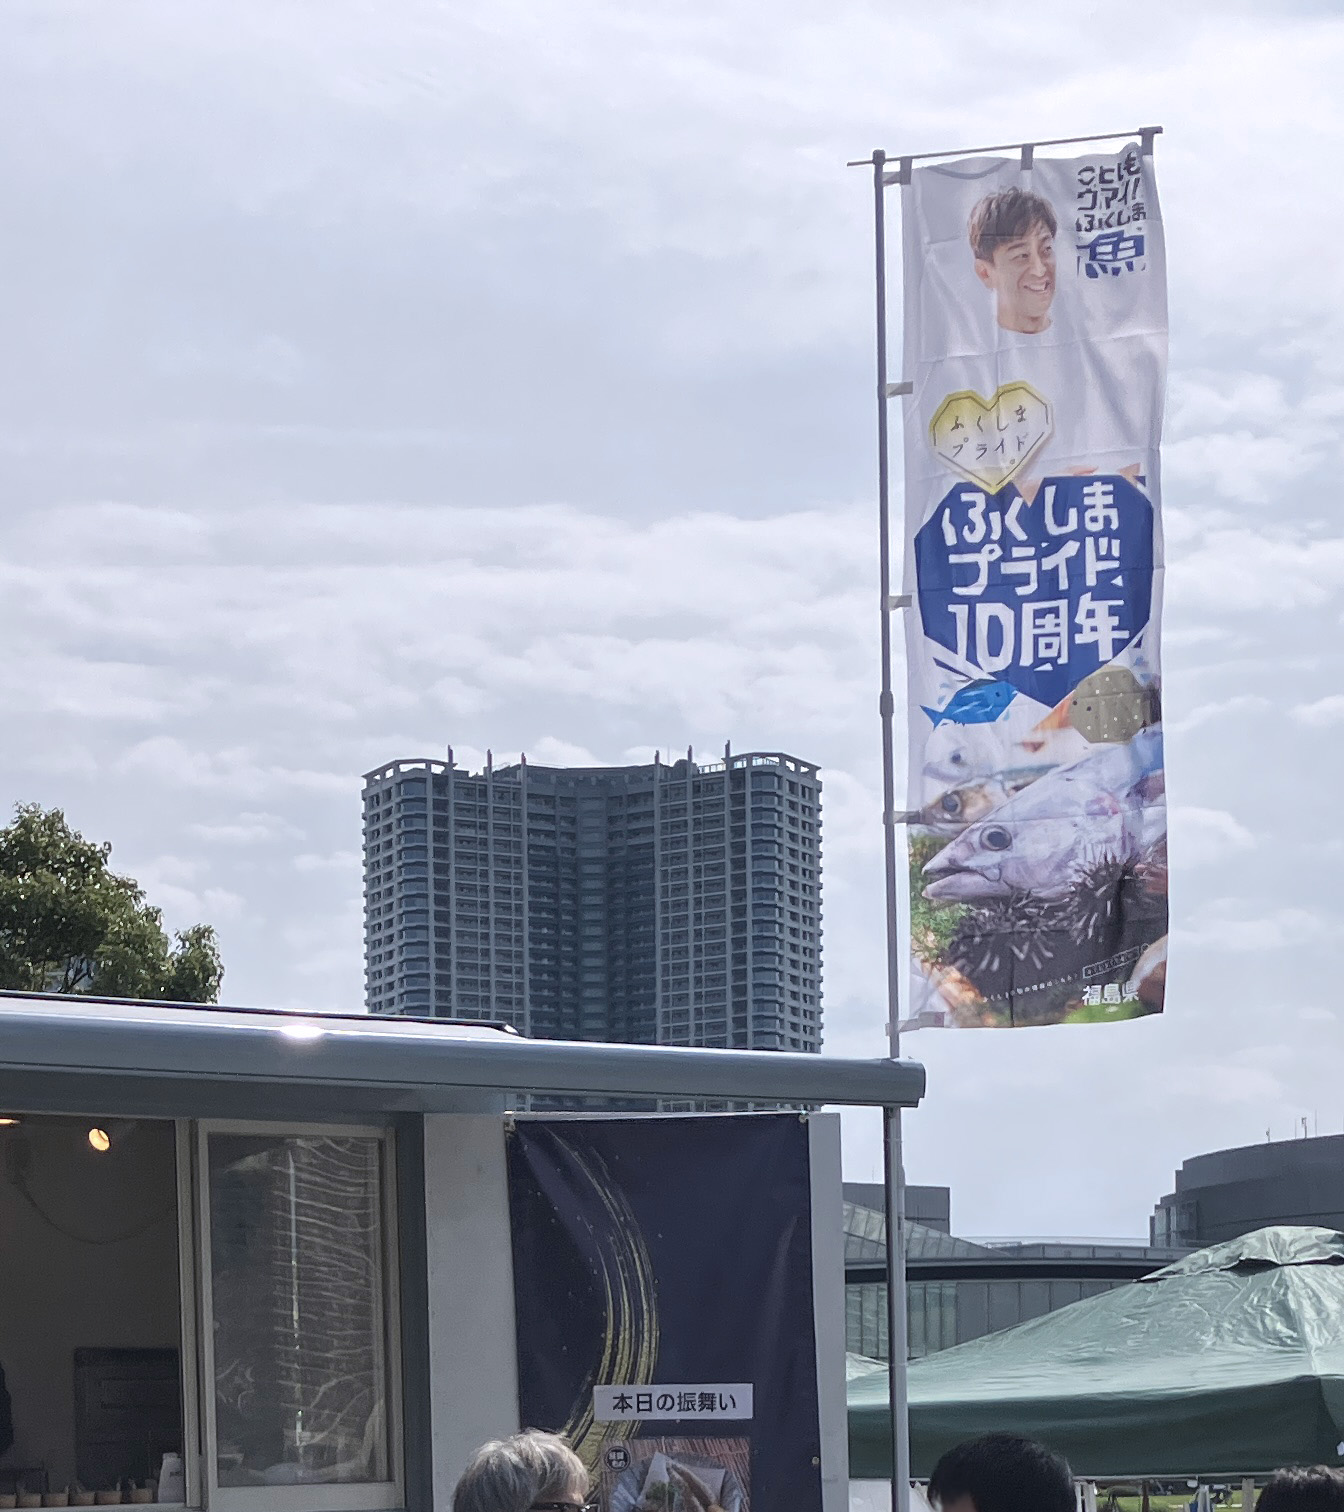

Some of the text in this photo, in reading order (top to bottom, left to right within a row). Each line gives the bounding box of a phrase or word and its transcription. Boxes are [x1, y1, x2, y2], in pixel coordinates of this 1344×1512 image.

[943, 480, 1120, 546] ふくしま
[947, 594, 1130, 671] 10周年
[612, 1391, 738, 1414] 本日の振舞い
